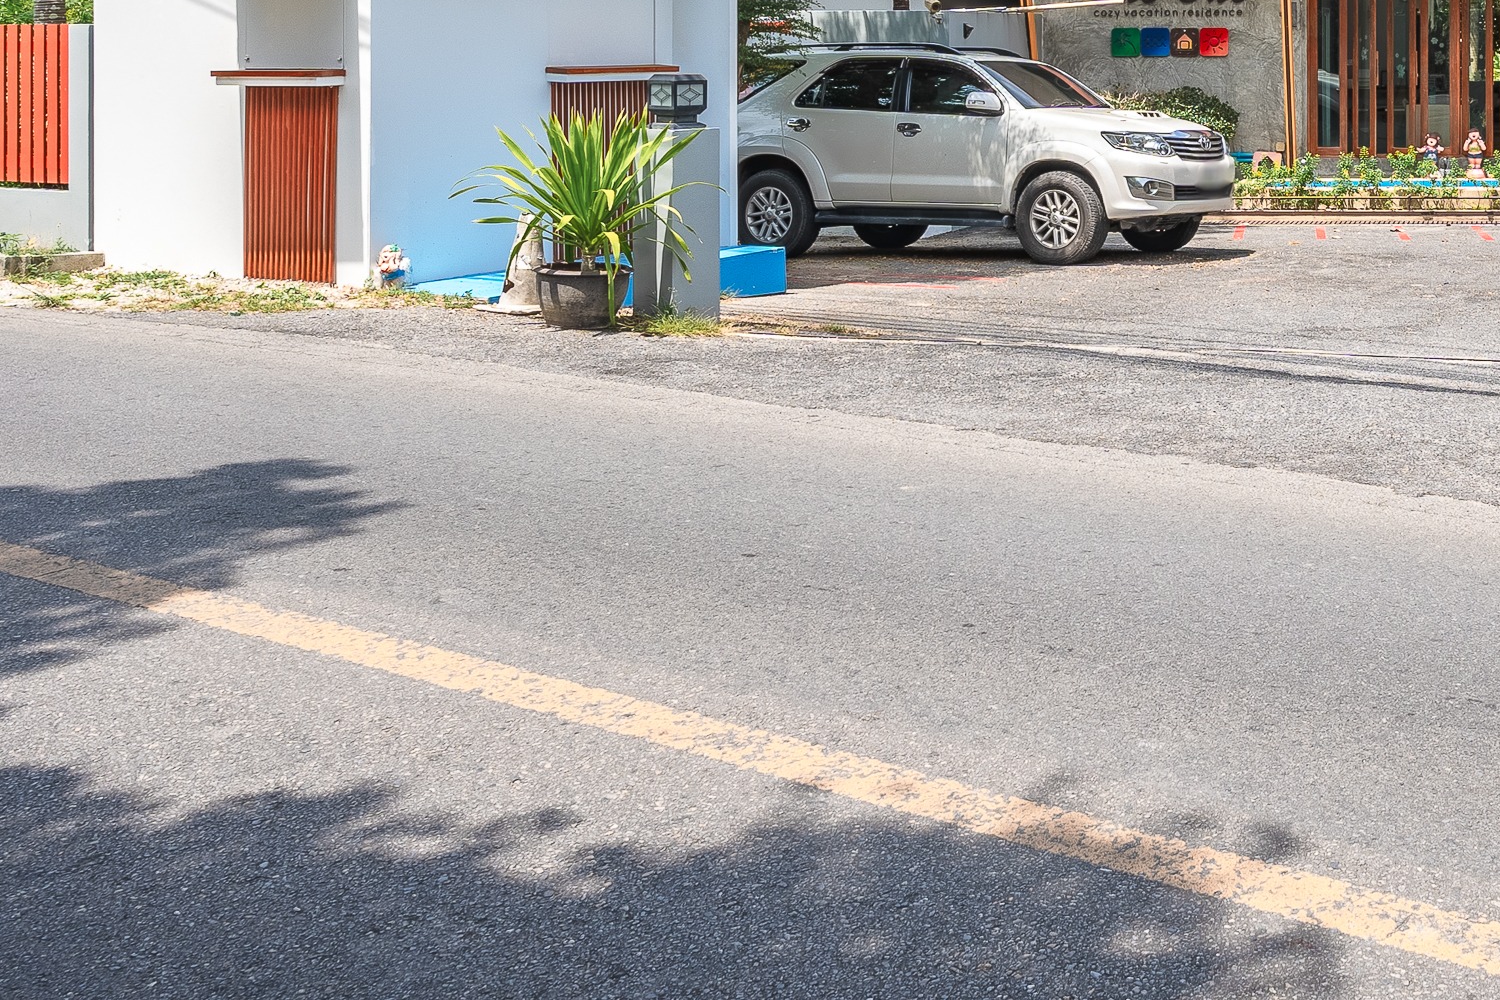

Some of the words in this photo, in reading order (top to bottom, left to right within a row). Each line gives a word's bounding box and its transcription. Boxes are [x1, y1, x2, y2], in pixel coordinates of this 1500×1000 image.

[1093, 9, 1120, 19] cozy
[1124, 8, 1179, 18] vacation
[1182, 7, 1243, 18] residence
